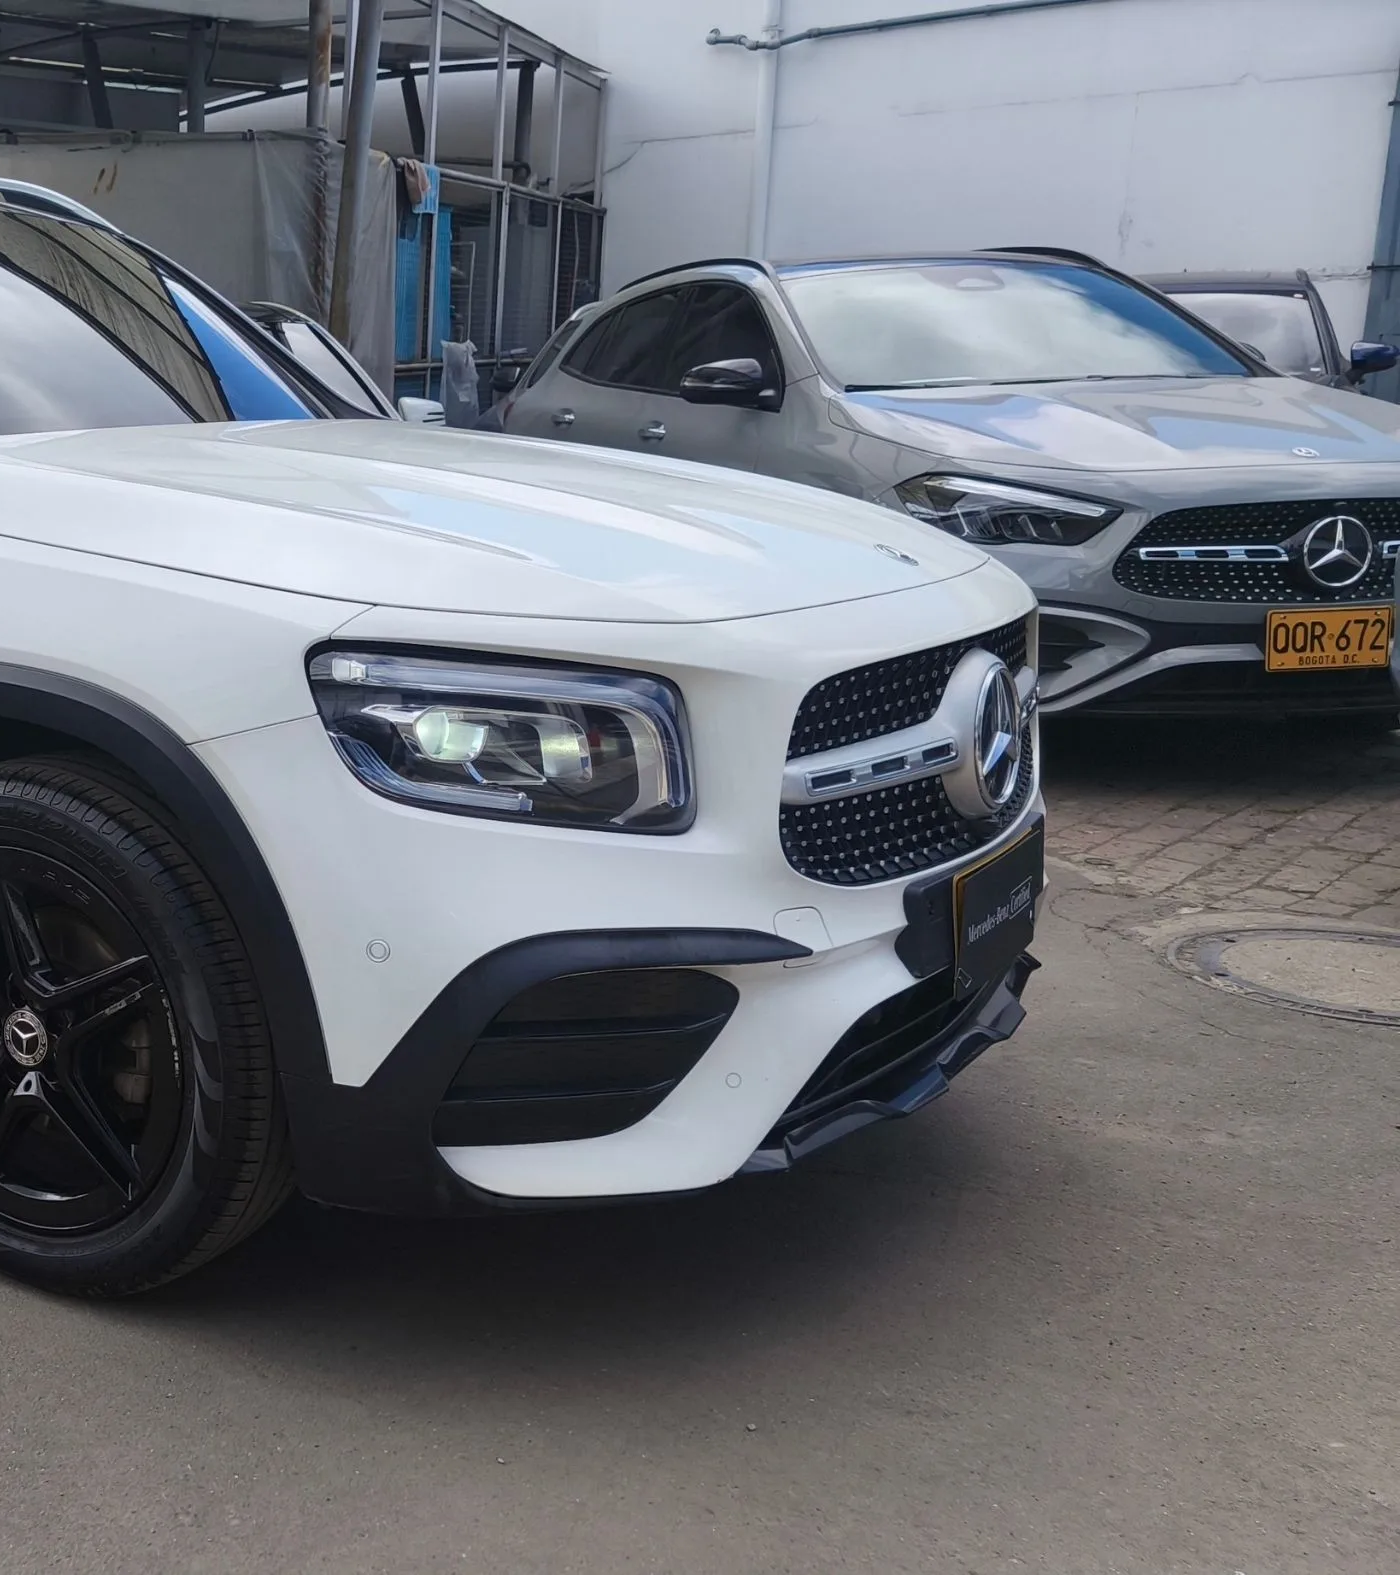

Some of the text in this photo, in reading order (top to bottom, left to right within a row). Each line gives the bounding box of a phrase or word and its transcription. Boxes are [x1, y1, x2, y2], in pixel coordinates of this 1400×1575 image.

[1335, 618, 1386, 652] 672
[1298, 655, 1337, 666] BOGOTA
[967, 903, 1011, 945] Mercedes-Benz
